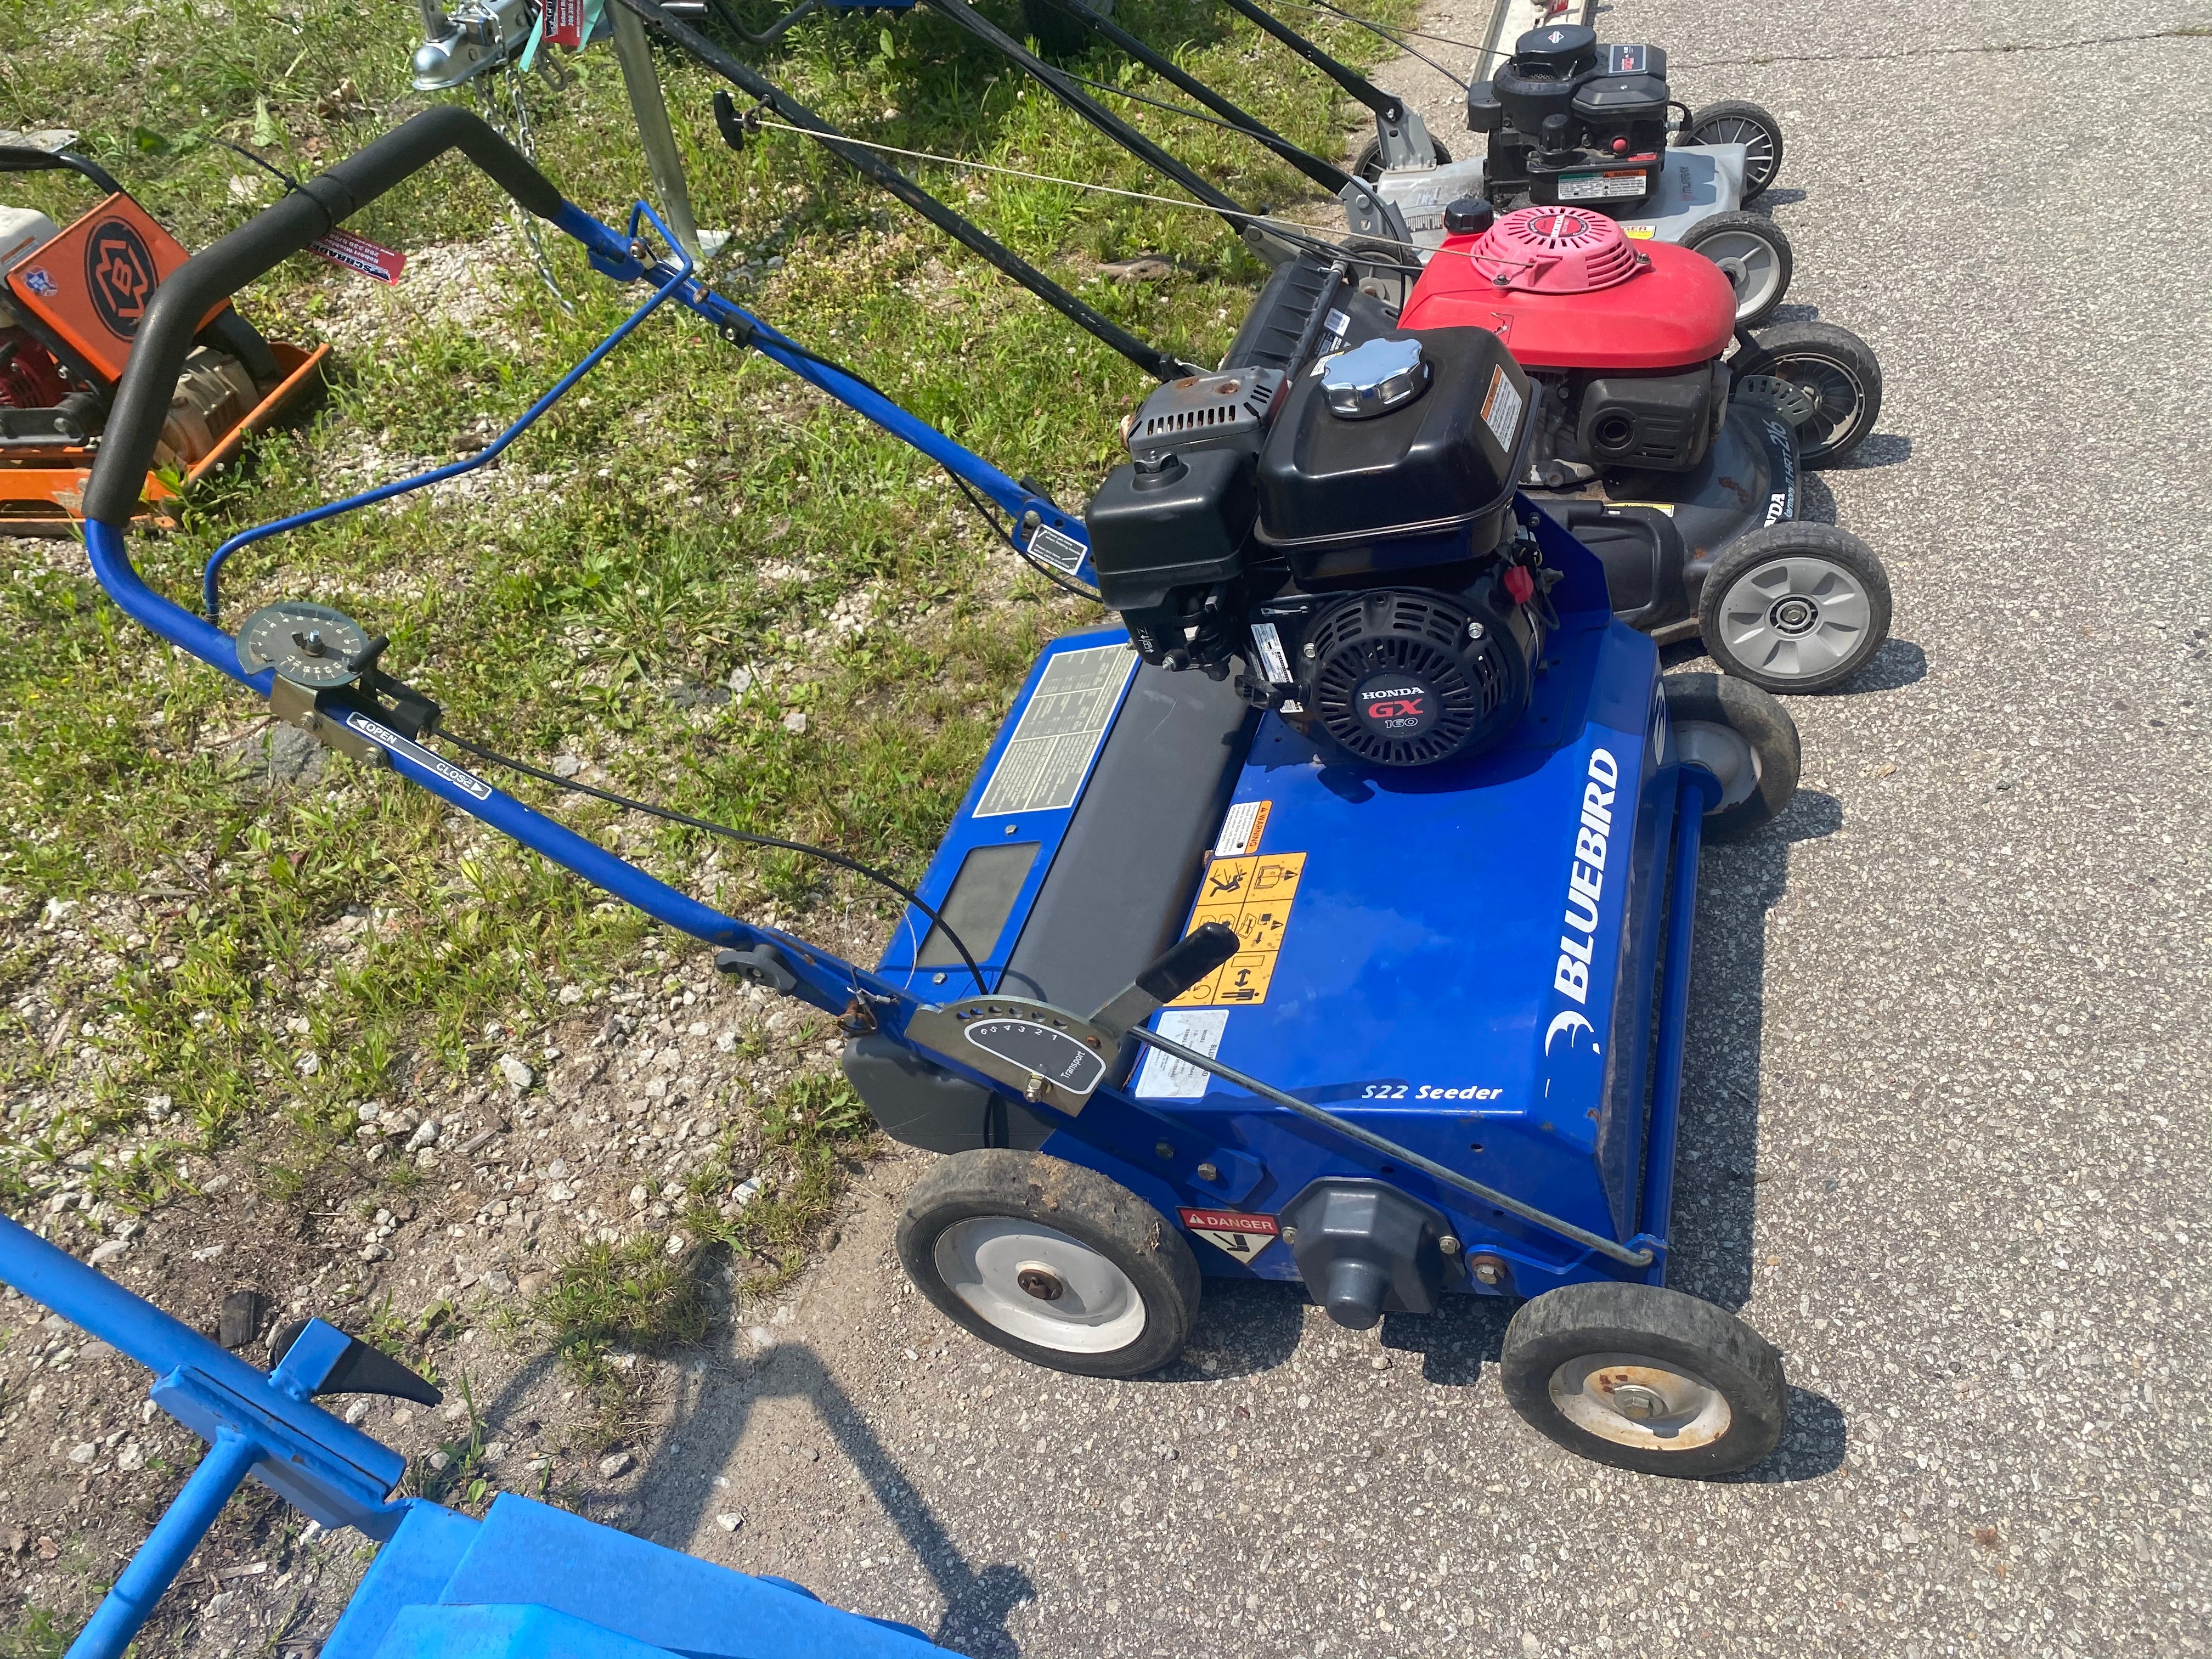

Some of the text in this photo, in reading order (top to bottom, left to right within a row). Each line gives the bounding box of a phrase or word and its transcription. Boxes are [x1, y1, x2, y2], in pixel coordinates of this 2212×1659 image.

[1679, 166, 1691, 194] MURRAY
[1761, 417, 1791, 452] 216
[1782, 449, 1794, 478] HRT
[1763, 493, 1785, 527] NDA
[1362, 687, 1425, 699] HONDA
[1368, 698, 1424, 718] GX
[366, 723, 397, 744] OPEN
[1385, 717, 1418, 729] 160
[436, 763, 473, 787] CLOSE
[1249, 815, 1266, 847] WARNING
[1554, 748, 1618, 1005] BLUEBIRD
[1060, 1051, 1086, 1079] Transport
[1362, 1085, 1503, 1099] S22 Seeder
[1207, 1216, 1273, 1230] DANGER
